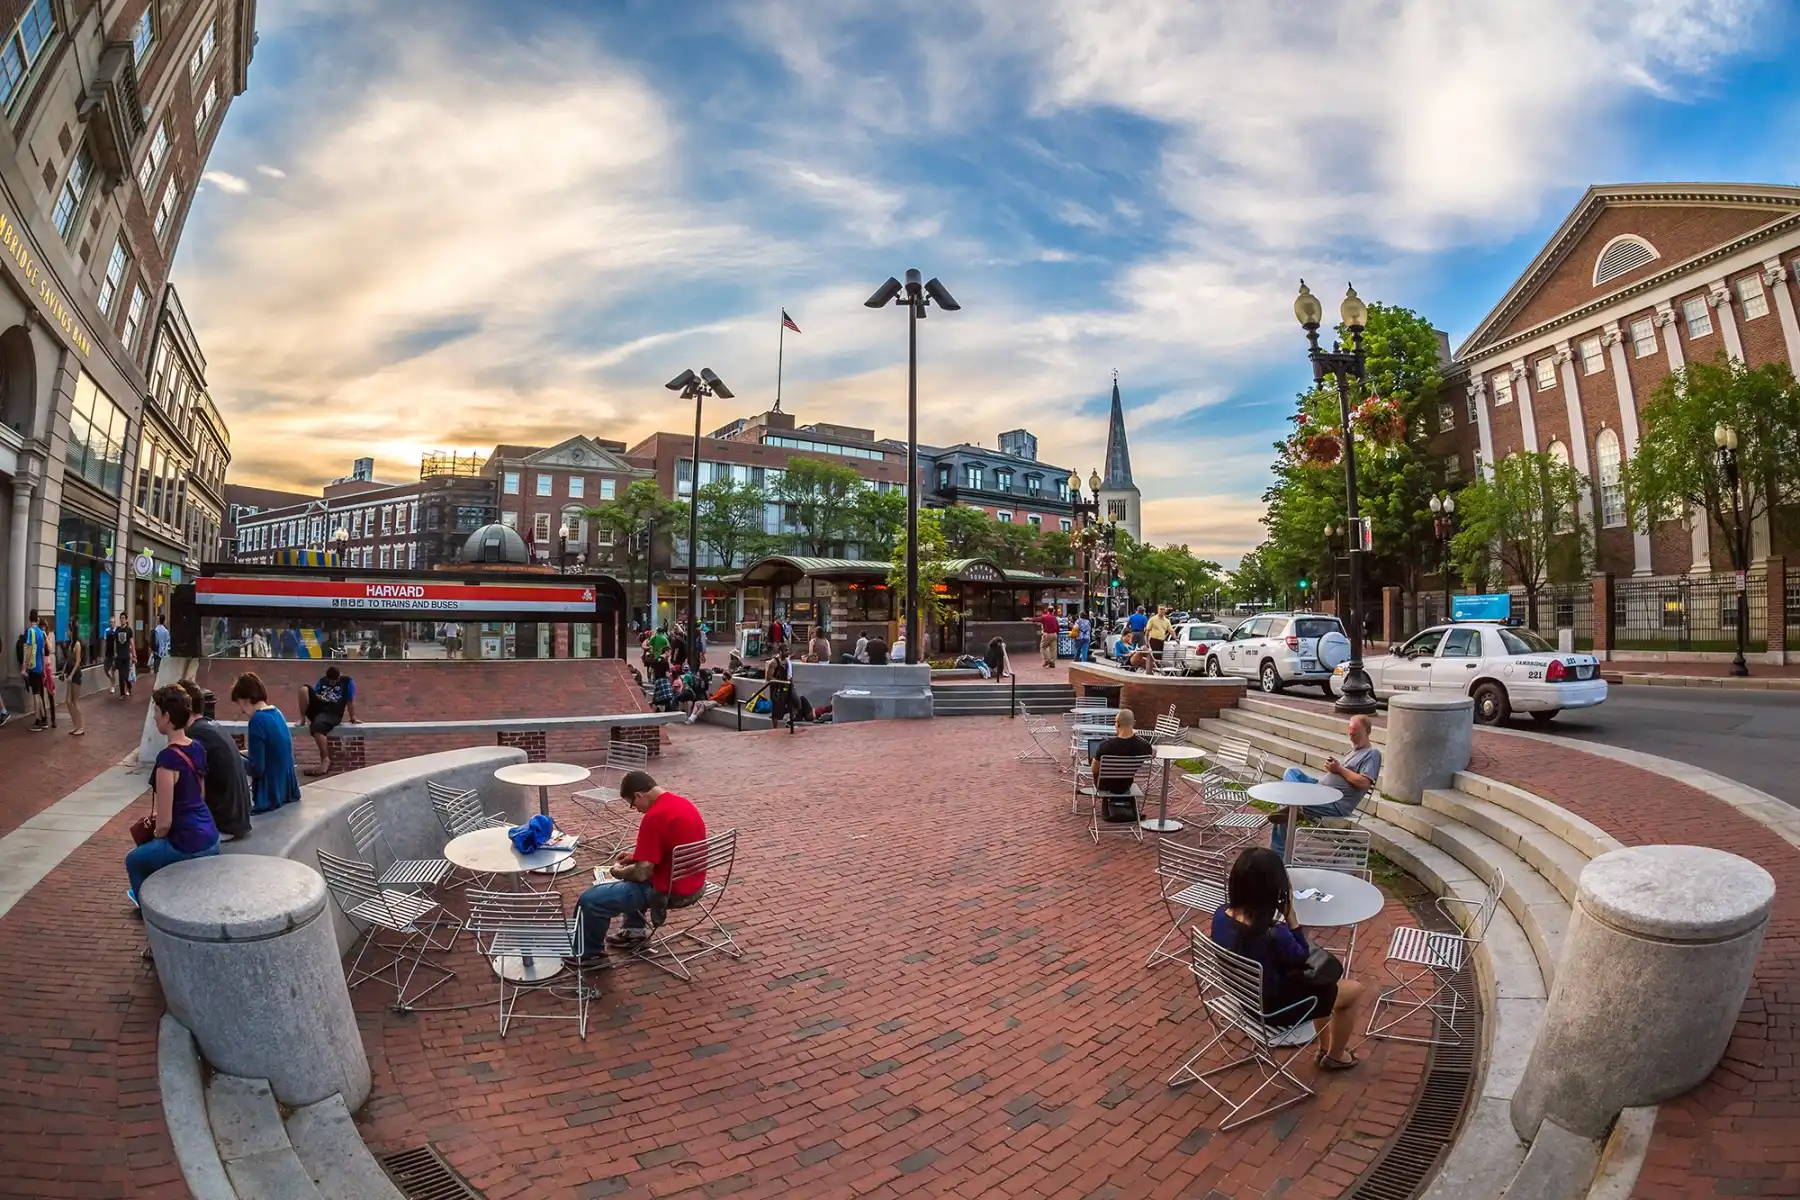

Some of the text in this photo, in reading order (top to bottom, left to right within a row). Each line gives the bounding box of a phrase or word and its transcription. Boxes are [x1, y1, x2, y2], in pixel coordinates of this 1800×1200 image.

[39, 280, 72, 333] SAVINGS
[72, 326, 91, 357] BANK
[965, 565, 998, 577] HARVARD
[366, 585, 425, 597] HARVARD
[368, 599, 459, 609] TO TRAINS AND BUSES
[1515, 660, 1548, 668] CAMBRIDGE
[1528, 671, 1542, 679] 221
